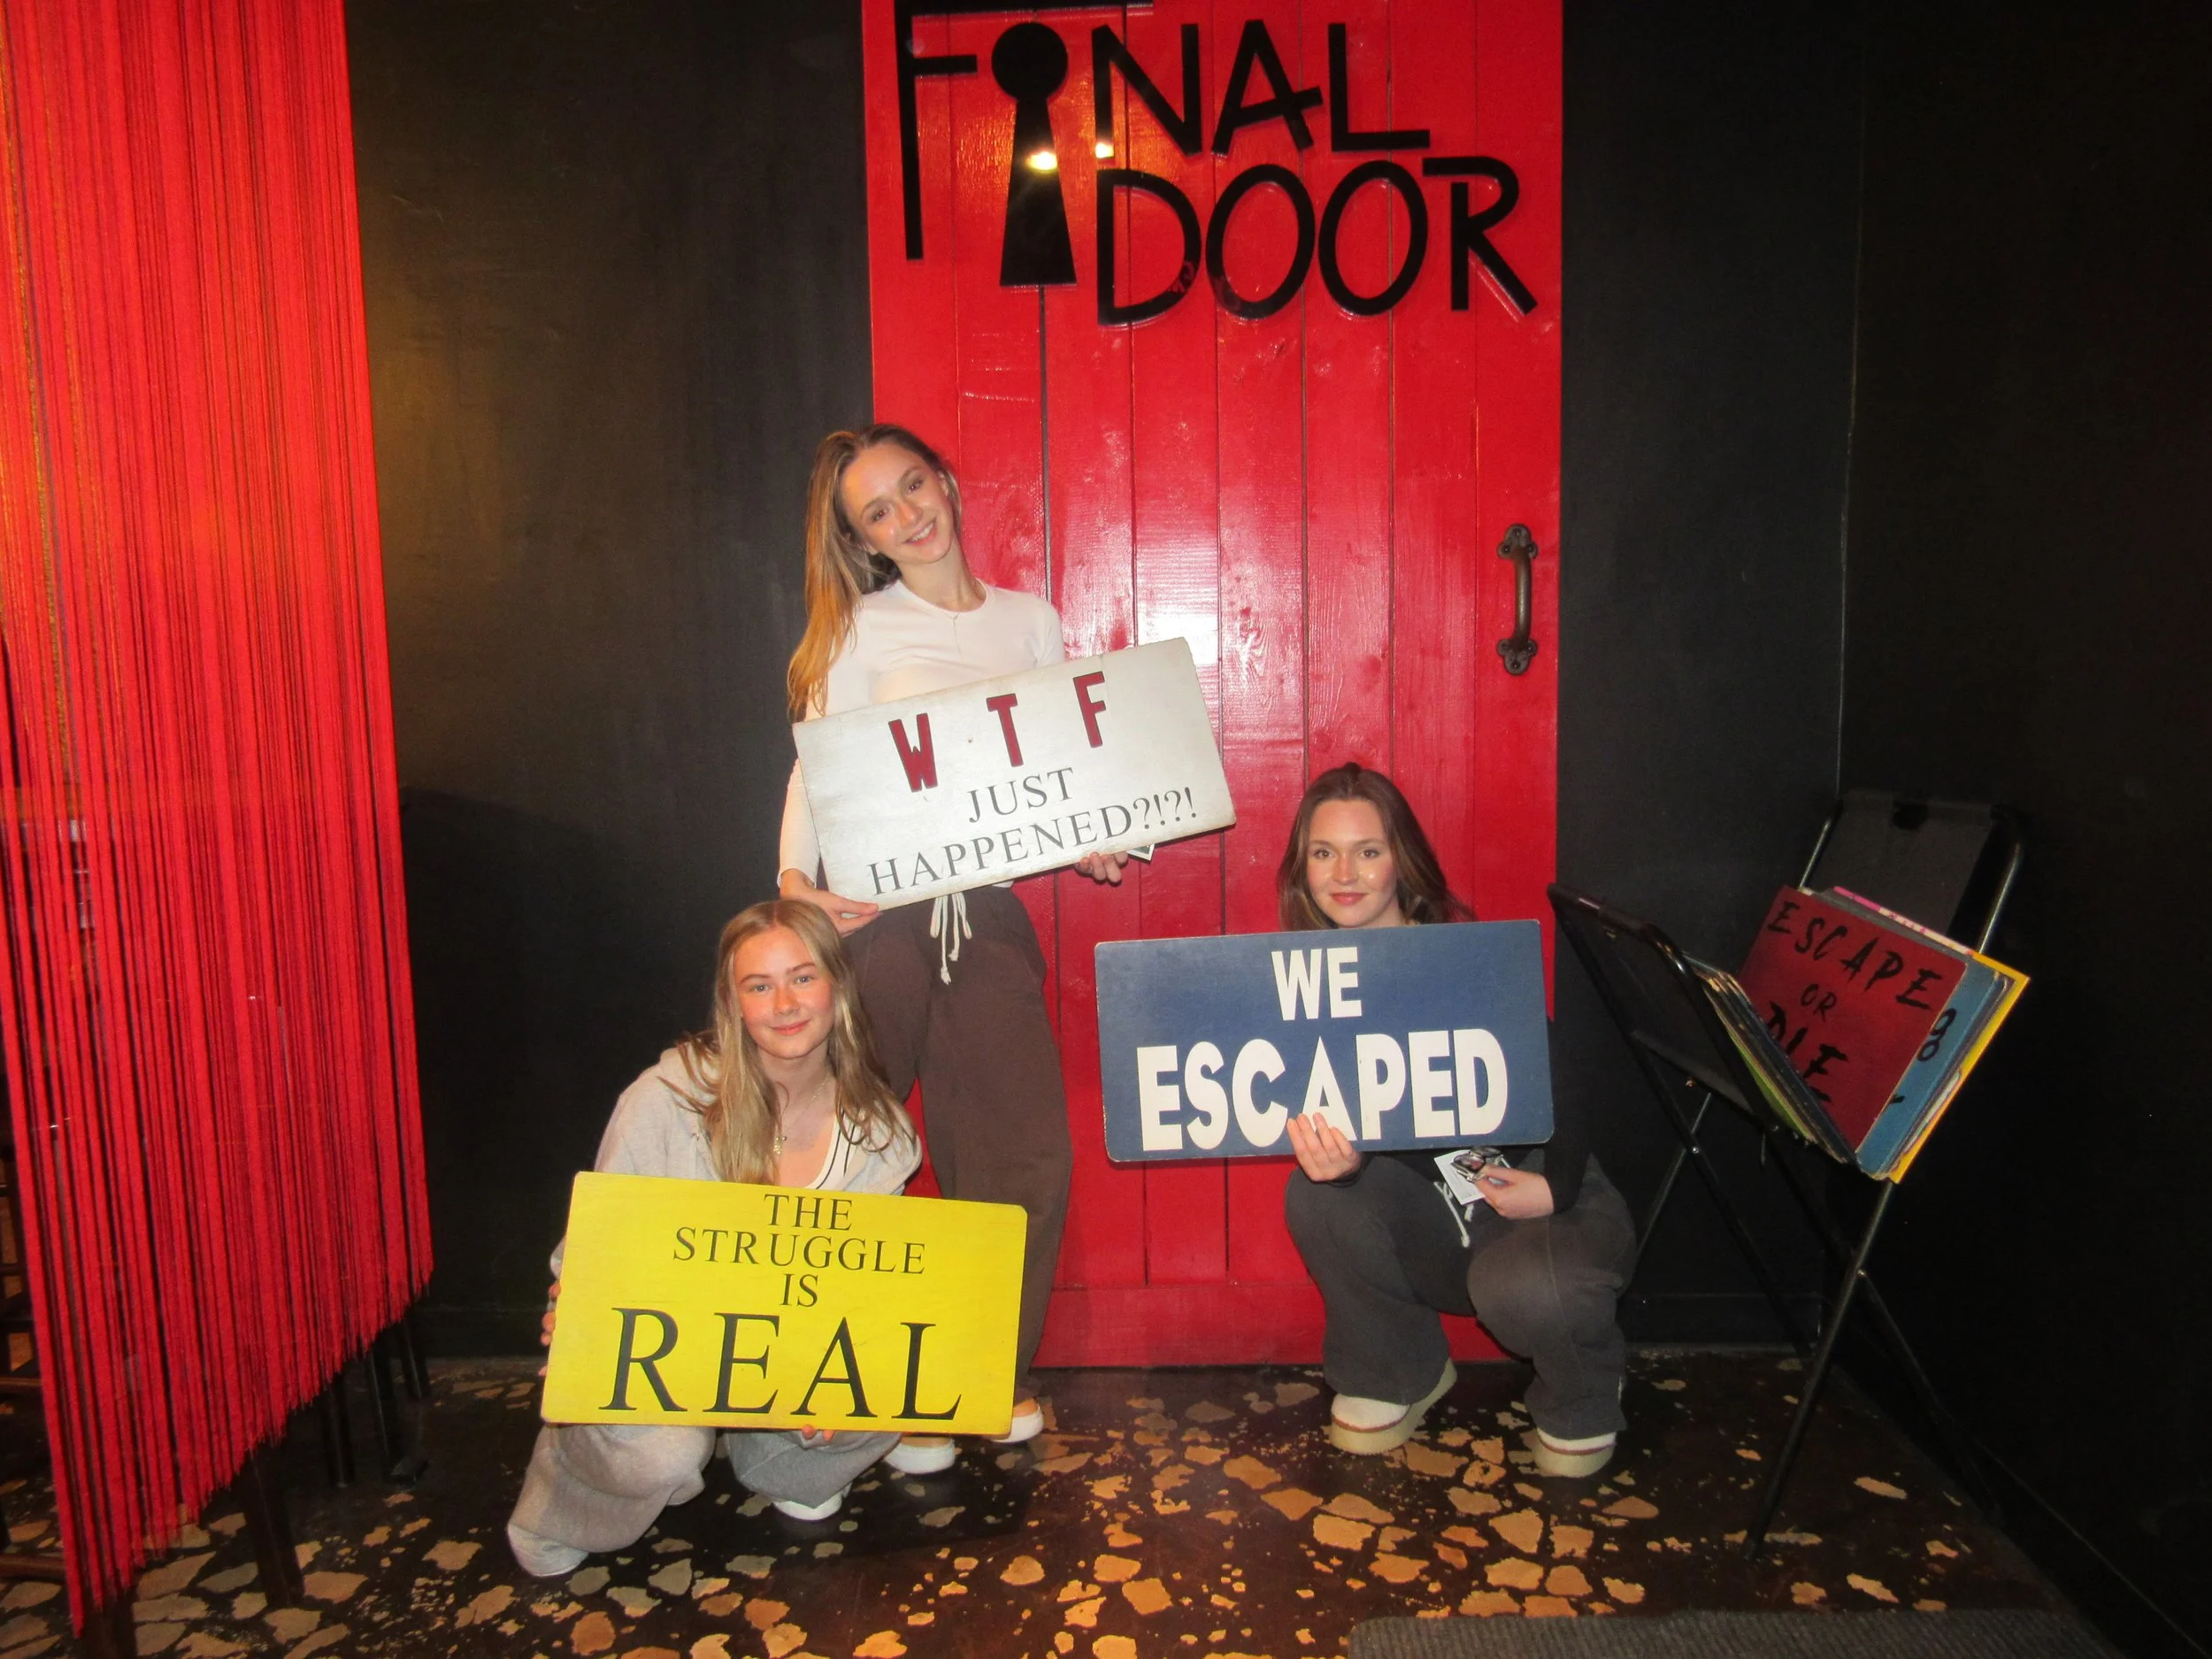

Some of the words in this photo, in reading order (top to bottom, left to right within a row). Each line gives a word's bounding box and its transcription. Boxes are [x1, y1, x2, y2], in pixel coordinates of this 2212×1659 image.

[1096, 156, 1539, 326] DOOR
[967, 766, 1074, 824] JUST
[866, 787, 1198, 896] HAPPENED?!?!
[1271, 946, 1363, 1022] WE
[1767, 901, 1943, 1010] ESCAPE
[1801, 983, 1837, 1022] OR
[1136, 1028, 1509, 1151] ESCAPED
[673, 1226, 926, 1275] STRUGGLE
[764, 1194, 853, 1232] THE
[779, 1273, 819, 1308] IS
[598, 1307, 964, 1421] REAL
